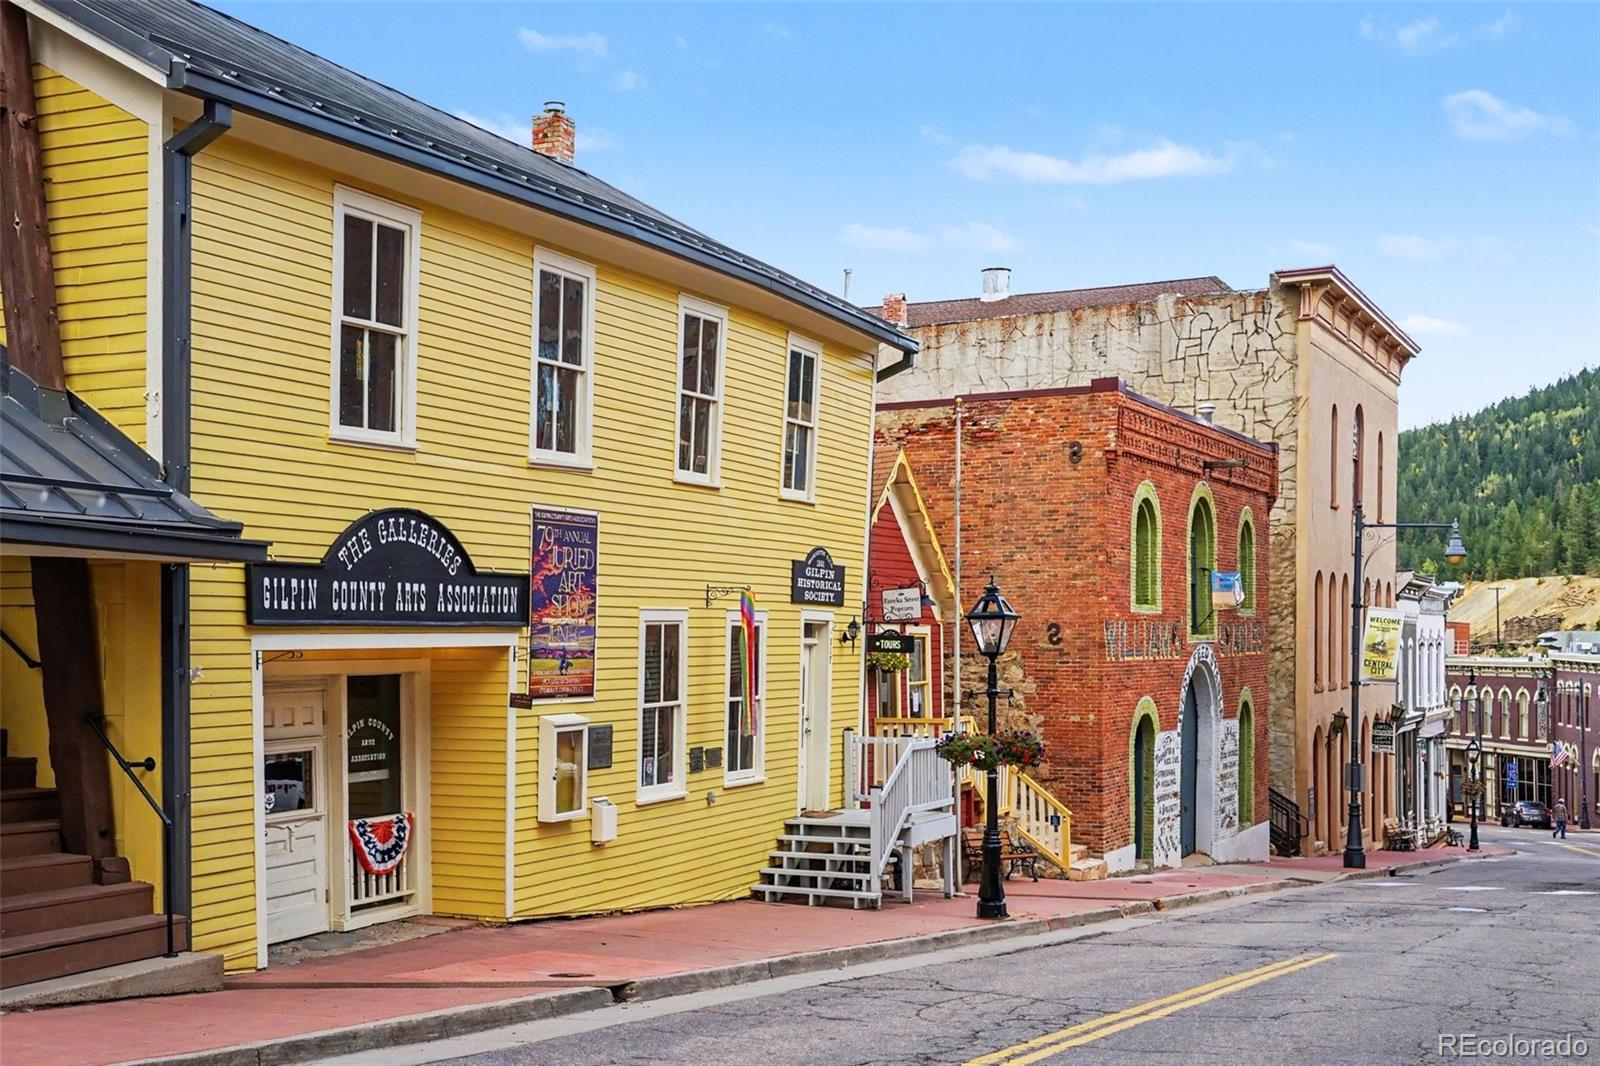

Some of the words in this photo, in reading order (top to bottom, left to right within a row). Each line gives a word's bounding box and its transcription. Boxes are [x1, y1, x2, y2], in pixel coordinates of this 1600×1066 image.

[338, 528, 372, 571] THE
[378, 517, 462, 577] GALLERIES
[805, 567, 835, 579] GILPIN
[558, 570, 586, 593] ART
[797, 578, 841, 591] HISTORICAL
[263, 576, 318, 610] GILPIN
[332, 580, 386, 612] COUNTY
[395, 582, 427, 612] ARTS
[437, 583, 518, 614] ASSOCIATION
[804, 591, 835, 602] SOCIETY
[890, 605, 914, 613] Popcorn
[1370, 616, 1402, 626] WELCOME
[880, 640, 902, 650] TOURS
[1363, 658, 1394, 670] CENTRAL
[1370, 667, 1387, 676] CITY
[368, 717, 394, 740] COUNTY
